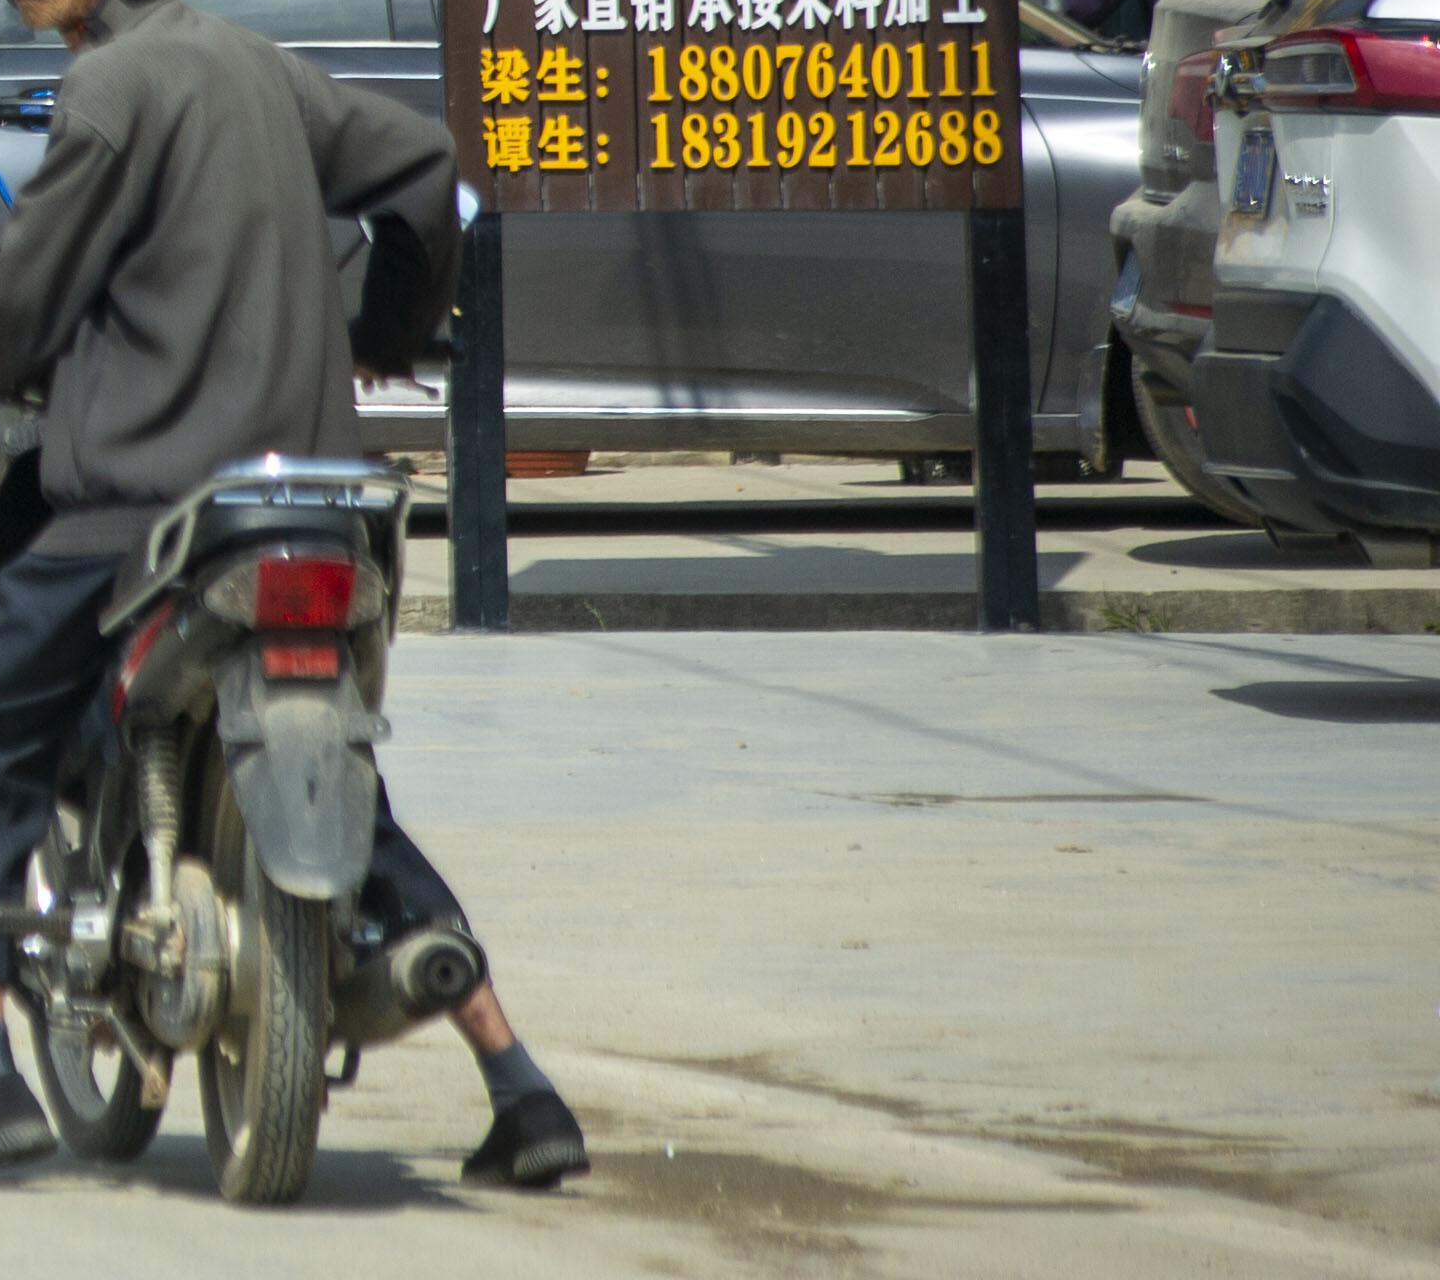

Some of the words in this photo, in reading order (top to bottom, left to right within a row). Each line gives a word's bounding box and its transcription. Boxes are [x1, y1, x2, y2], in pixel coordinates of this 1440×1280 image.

[481, 46, 611, 104] 梁生：
[648, 41, 999, 103] 18807640111
[481, 116, 611, 174] 谭生：
[648, 109, 1004, 170] 18319212688
